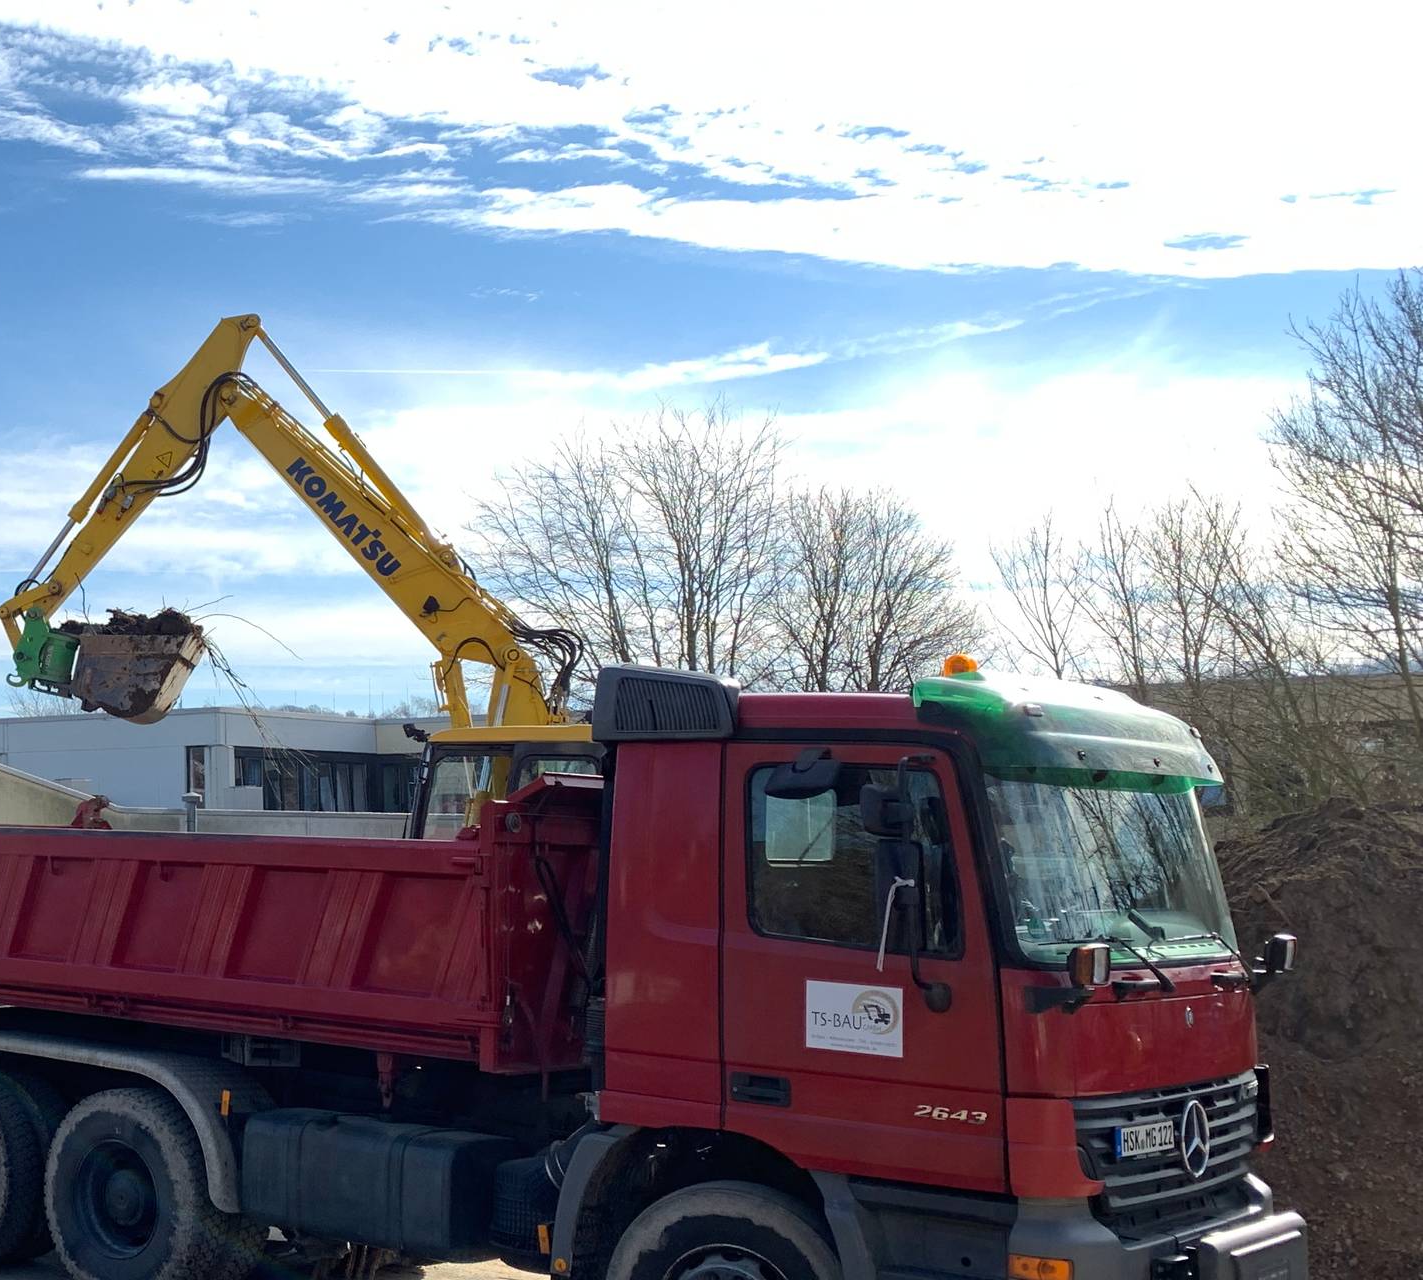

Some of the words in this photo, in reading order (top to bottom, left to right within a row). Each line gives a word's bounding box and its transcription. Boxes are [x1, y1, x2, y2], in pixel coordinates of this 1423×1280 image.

[286, 457, 401, 576] KOMATSU
[811, 1011, 862, 1030] TS-BAU
[915, 1105, 988, 1125] 2643
[1123, 1130, 1141, 1152] HSK
